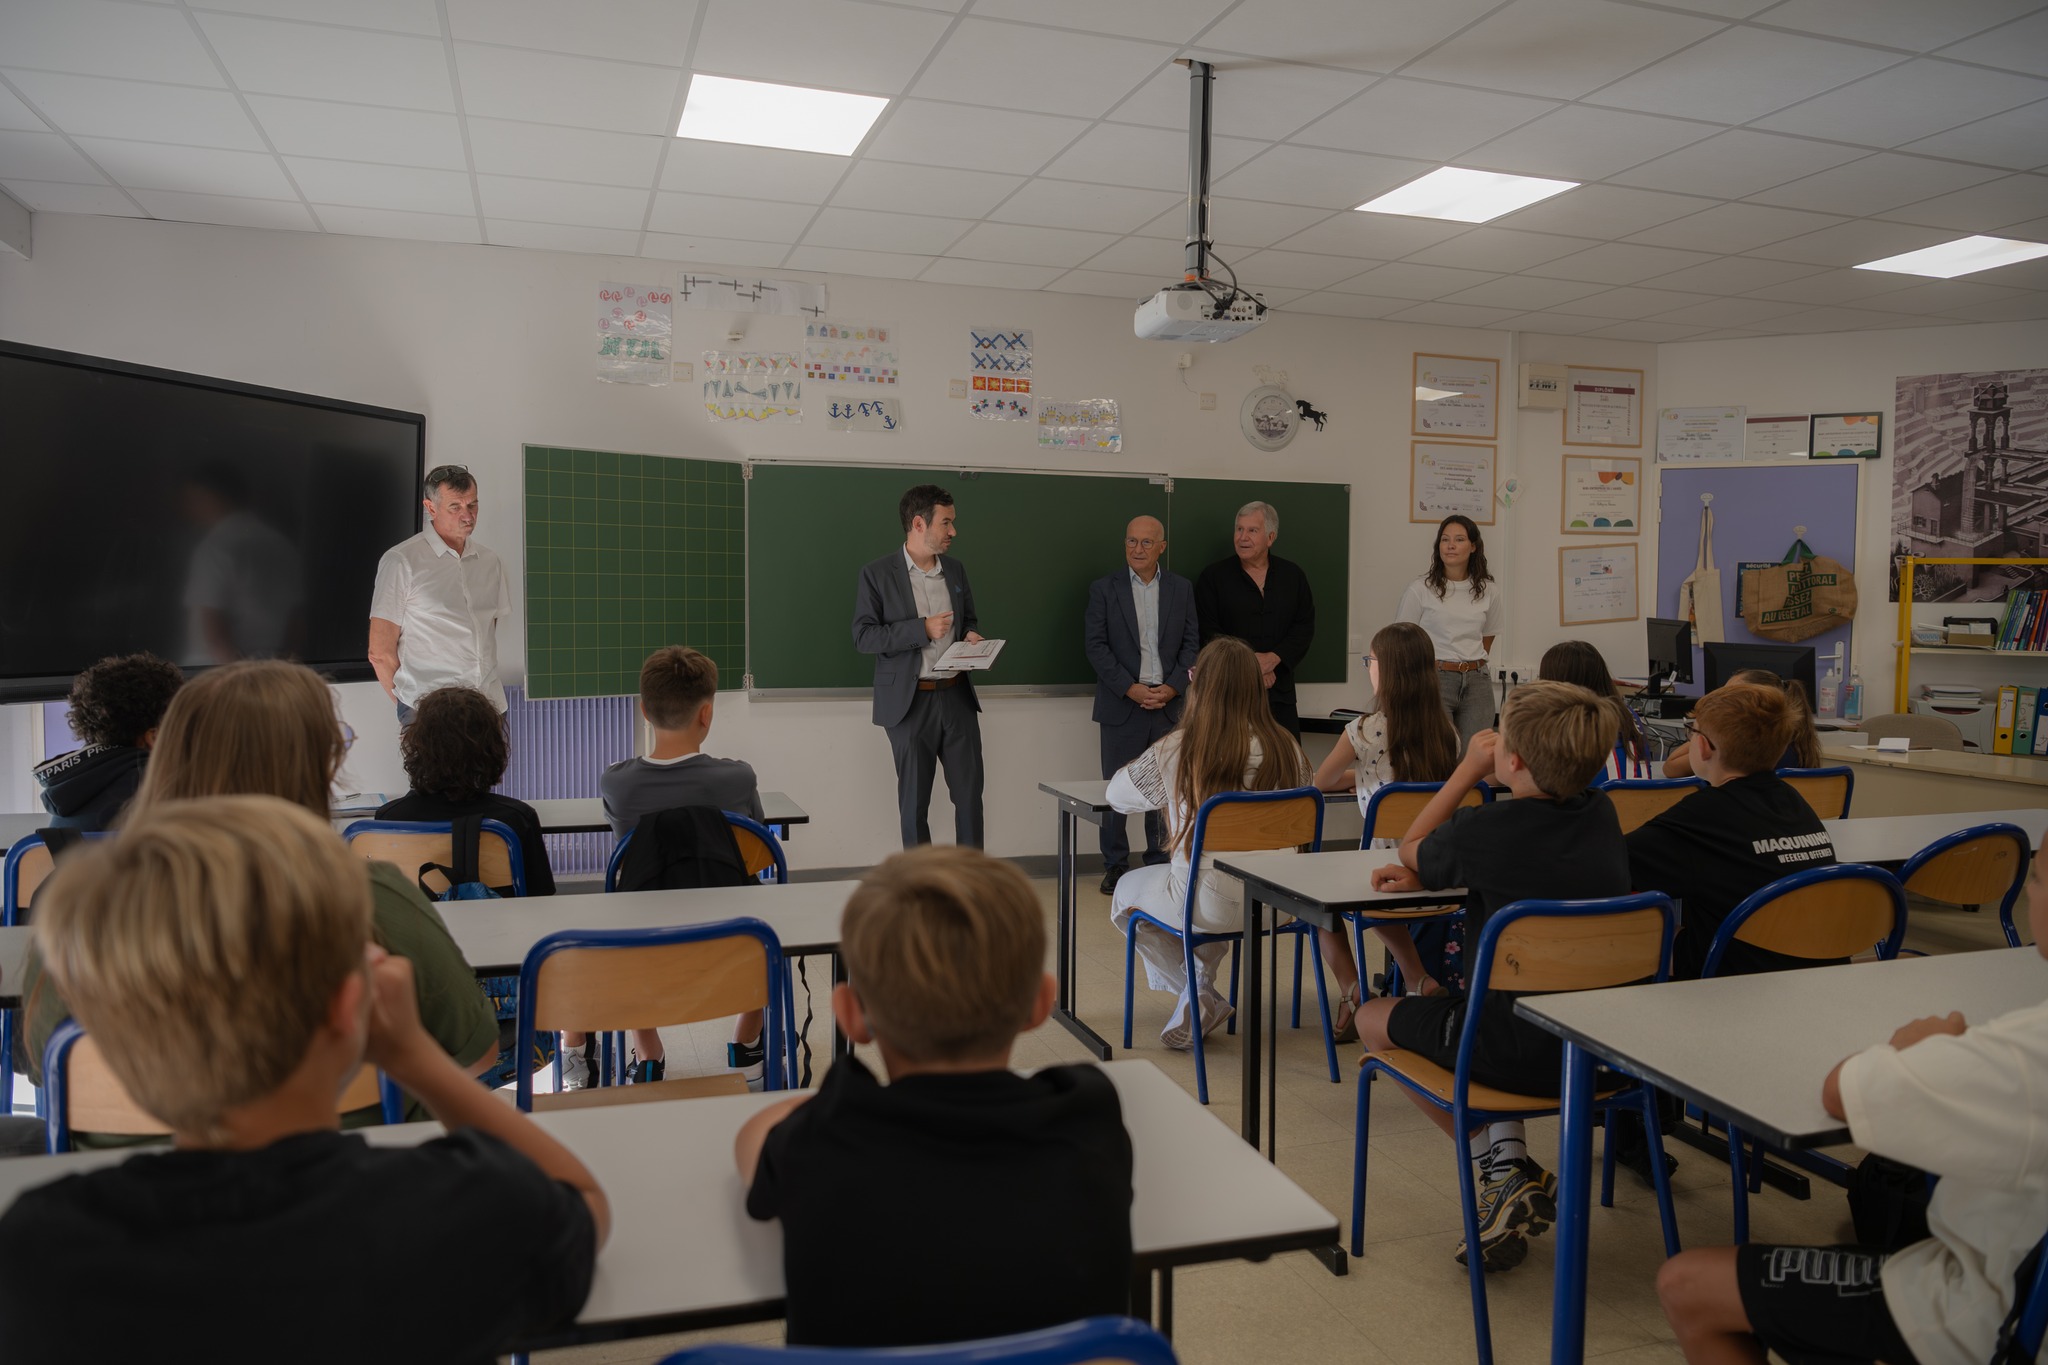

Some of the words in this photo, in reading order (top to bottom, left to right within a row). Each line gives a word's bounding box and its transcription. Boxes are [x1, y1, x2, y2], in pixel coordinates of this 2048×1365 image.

[45, 755, 81, 778] PARIS
[1752, 831, 1831, 854] MAQUININH
[1777, 851, 1810, 863] WEEKEND
[1769, 1247, 1888, 1286] PUM
